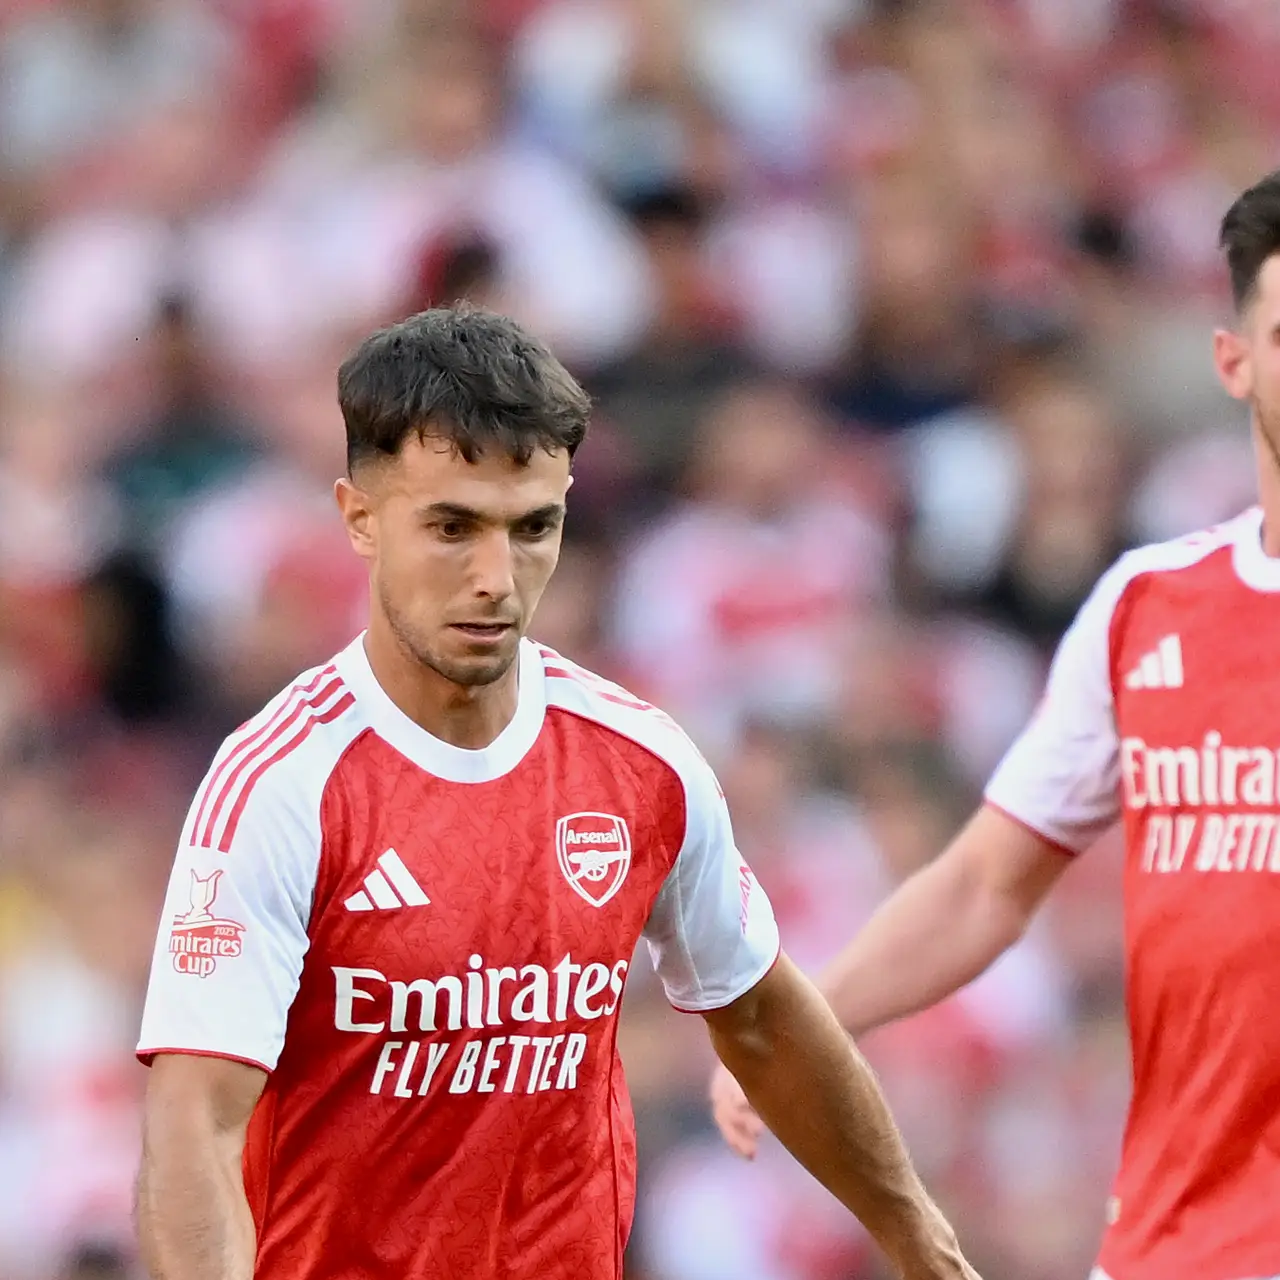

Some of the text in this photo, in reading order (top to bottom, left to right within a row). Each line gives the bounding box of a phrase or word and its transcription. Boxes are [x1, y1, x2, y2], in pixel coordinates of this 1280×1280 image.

[566, 829, 619, 845] Arsenal
[1142, 813, 1198, 874] FLY
[170, 931, 241, 957] mirates
[174, 951, 215, 978] Cup
[330, 952, 628, 1034] Emirates
[370, 1032, 587, 1098] FLY BETTER
